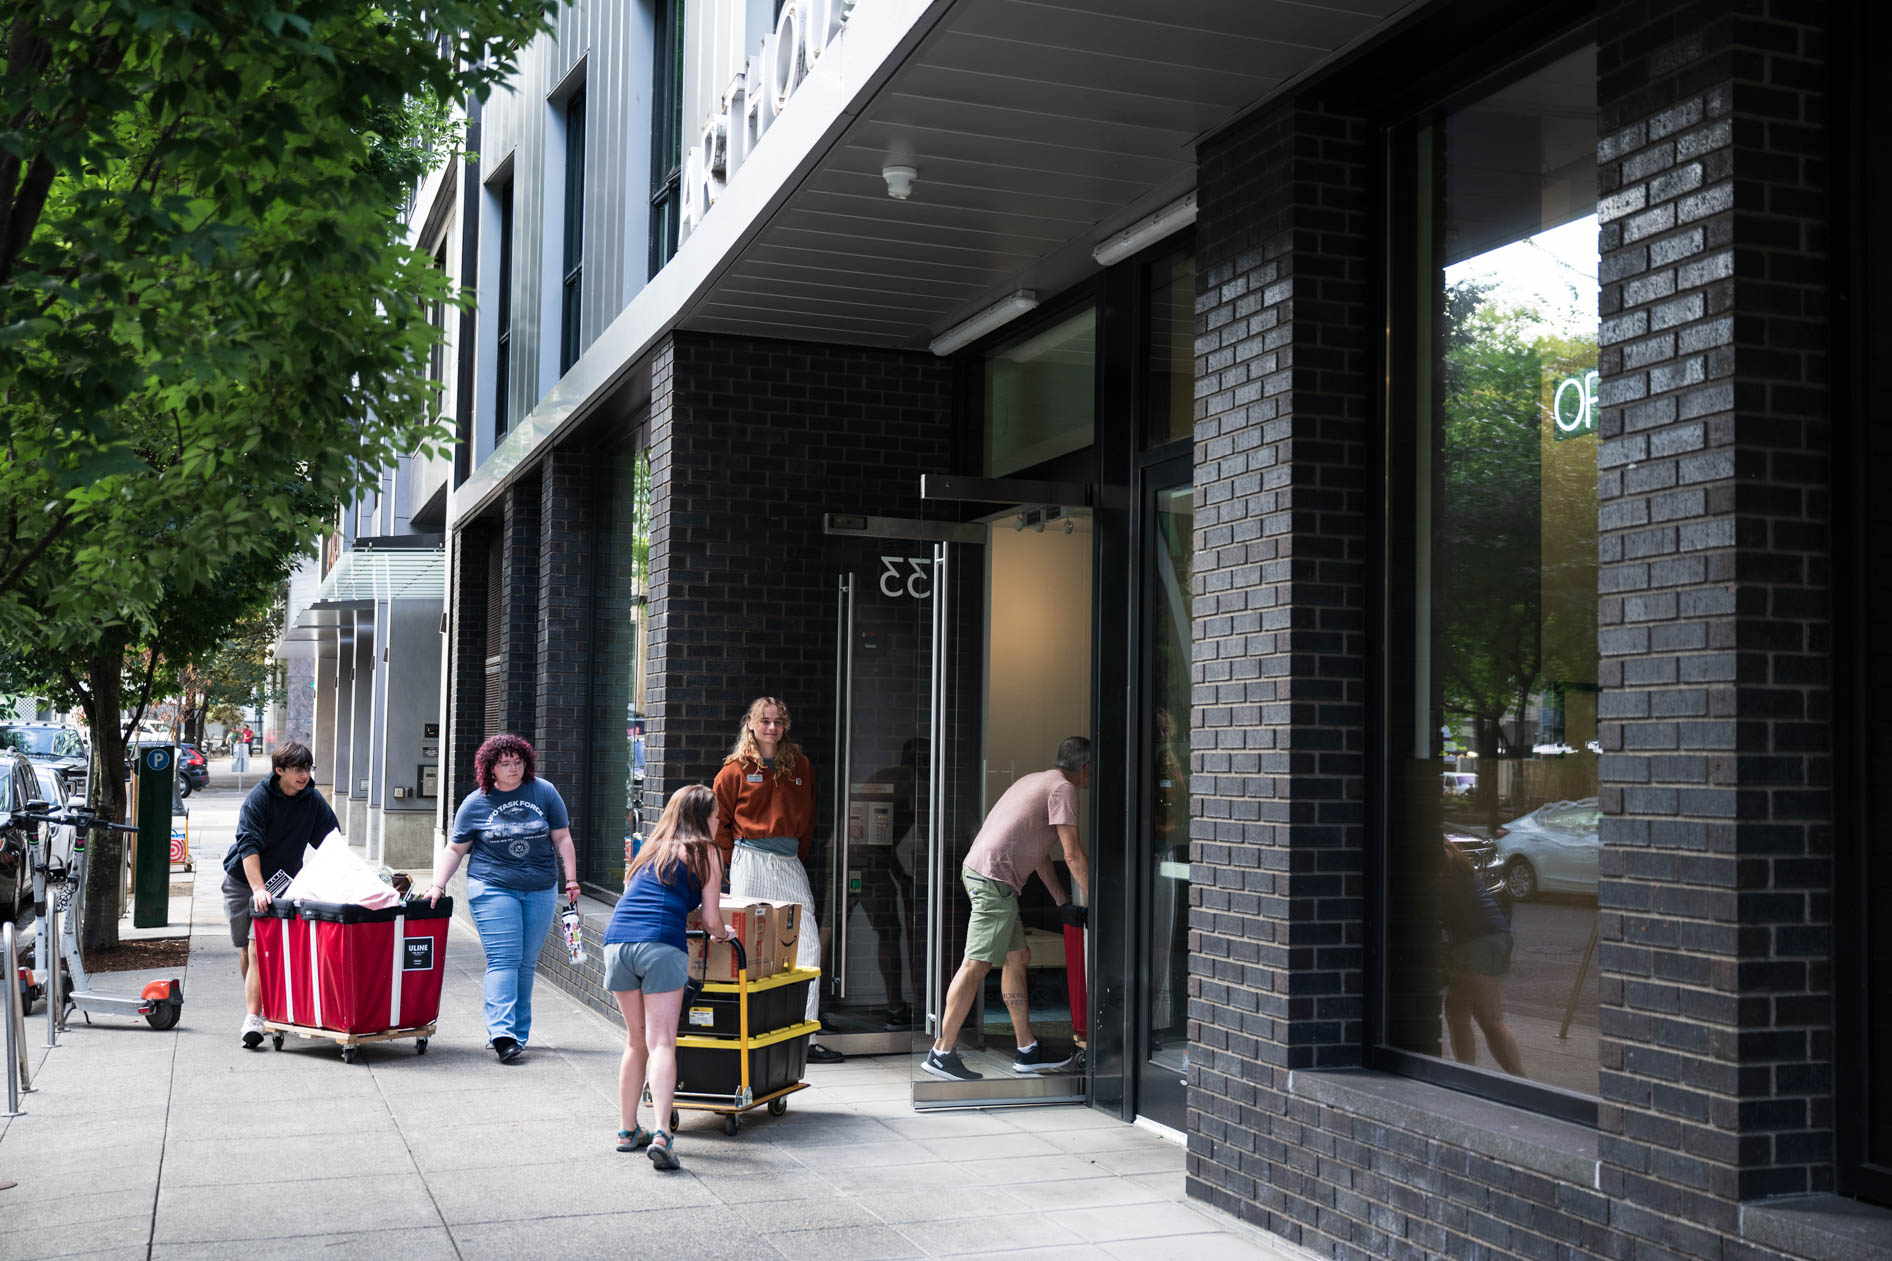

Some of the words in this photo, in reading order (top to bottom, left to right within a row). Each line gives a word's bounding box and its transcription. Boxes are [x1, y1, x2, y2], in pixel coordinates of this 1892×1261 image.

[677, 0, 860, 248] ARTHOU
[154, 753, 164, 768] P
[497, 800, 519, 812] TASK
[520, 801, 544, 817] FORCE
